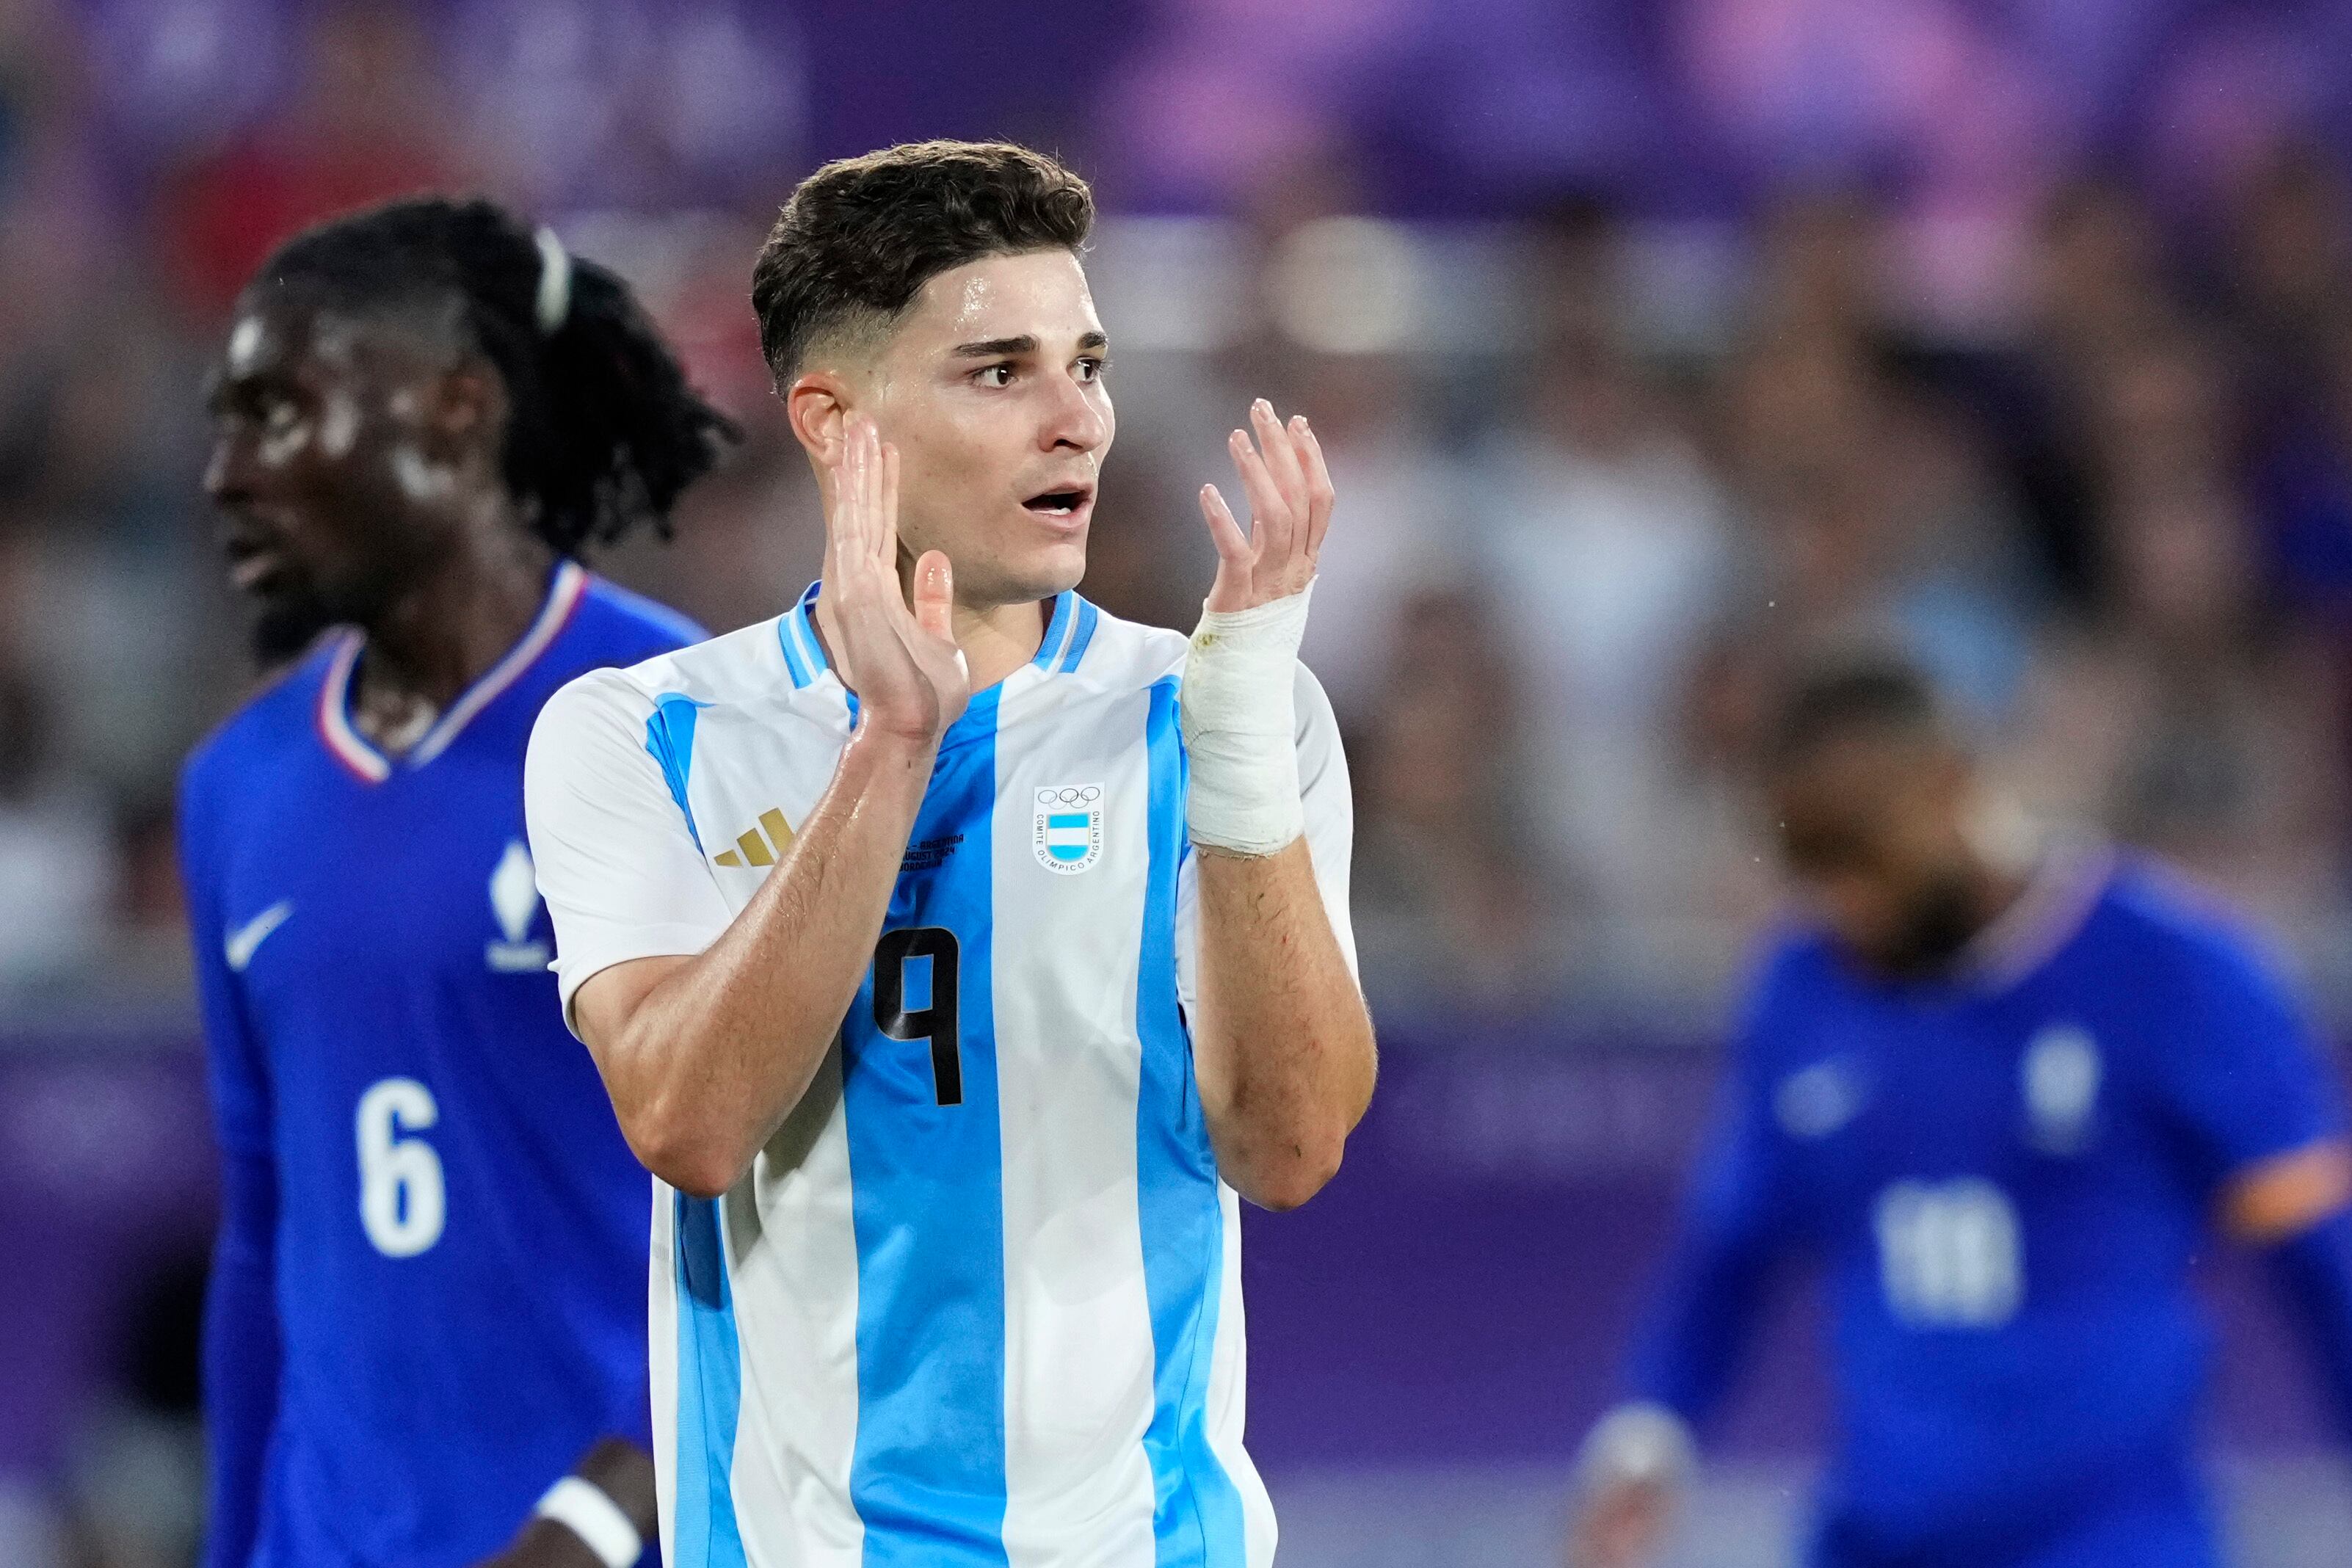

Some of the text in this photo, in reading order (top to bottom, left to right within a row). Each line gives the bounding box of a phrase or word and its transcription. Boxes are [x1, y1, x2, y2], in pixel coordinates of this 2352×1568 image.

[903, 850, 932, 862] UGUST
[1036, 810, 1100, 871] COMITE OLIMPICO ARGENTINO
[874, 927, 962, 1106] 9
[356, 1077, 446, 1259] 6
